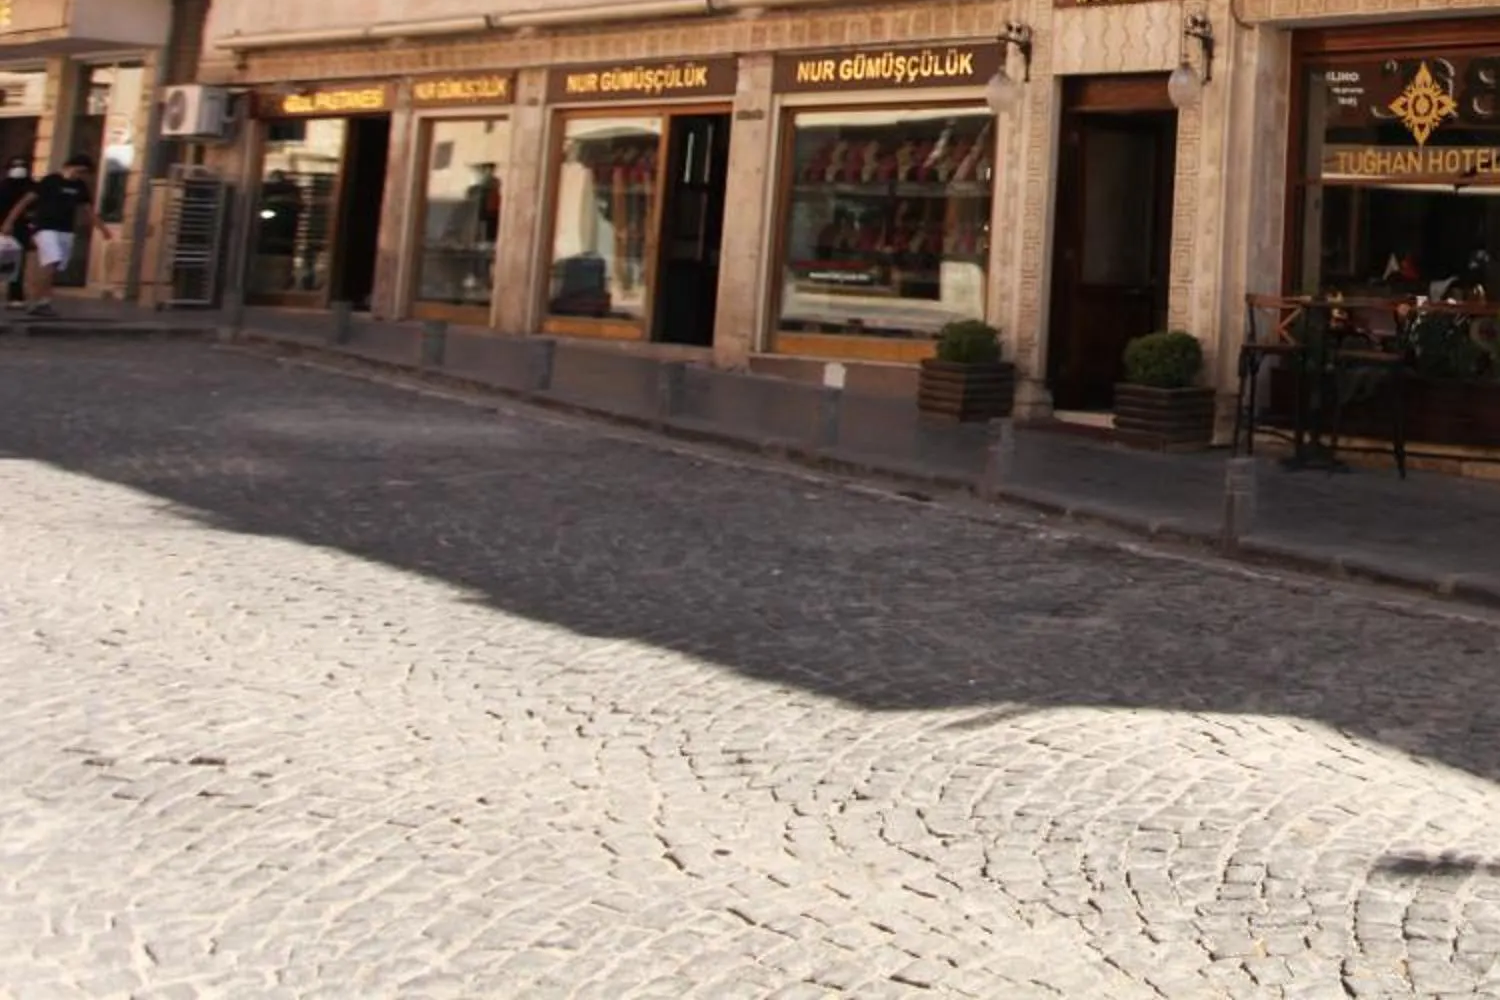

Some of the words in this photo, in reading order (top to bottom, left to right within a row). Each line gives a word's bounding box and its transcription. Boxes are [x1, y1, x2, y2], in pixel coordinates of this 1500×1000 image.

[566, 72, 598, 94] NUR
[600, 62, 707, 95] GÜMÜŞÇÜLÜK
[797, 59, 836, 83] NUR
[839, 49, 973, 83] GÜMÜŞÇÜLÜK
[1338, 149, 1424, 174] TUĞHAN
